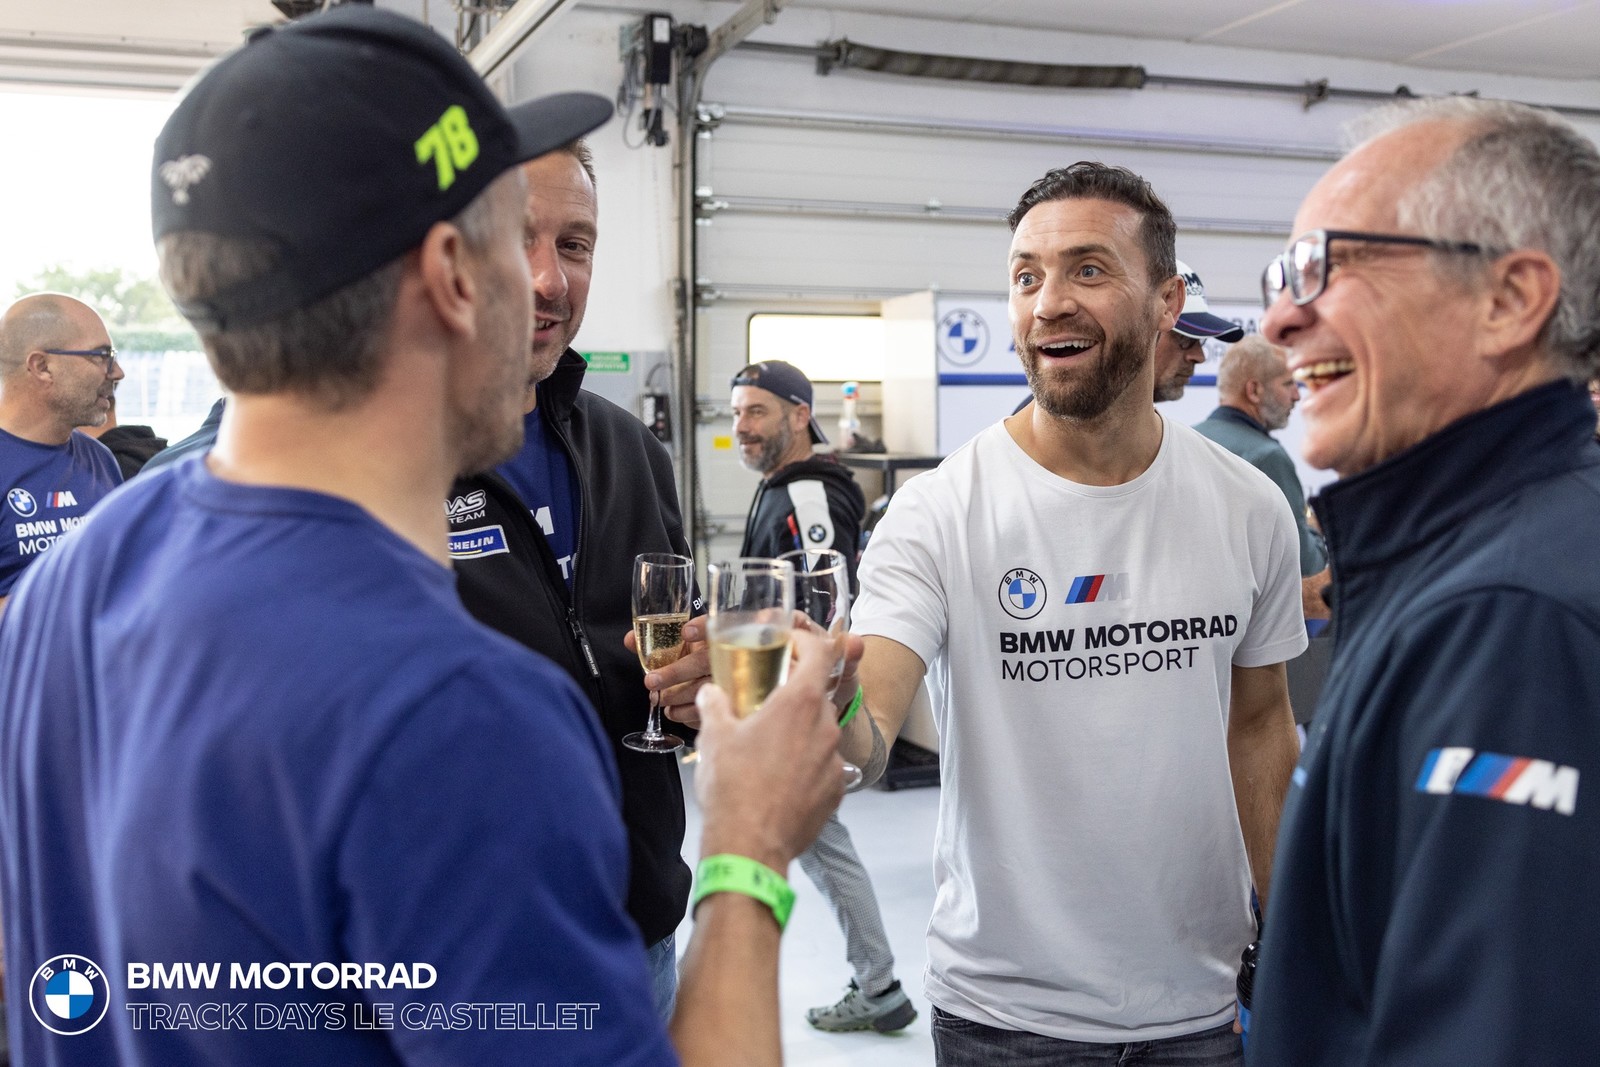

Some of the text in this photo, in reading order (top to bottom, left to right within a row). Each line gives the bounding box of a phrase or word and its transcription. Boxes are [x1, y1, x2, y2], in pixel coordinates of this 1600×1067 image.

[15, 520, 58, 538] BMW
[448, 509, 486, 524] TEAM
[1000, 614, 1238, 654] BMW MOTORRAD
[1002, 646, 1200, 682] MOTORSPORT
